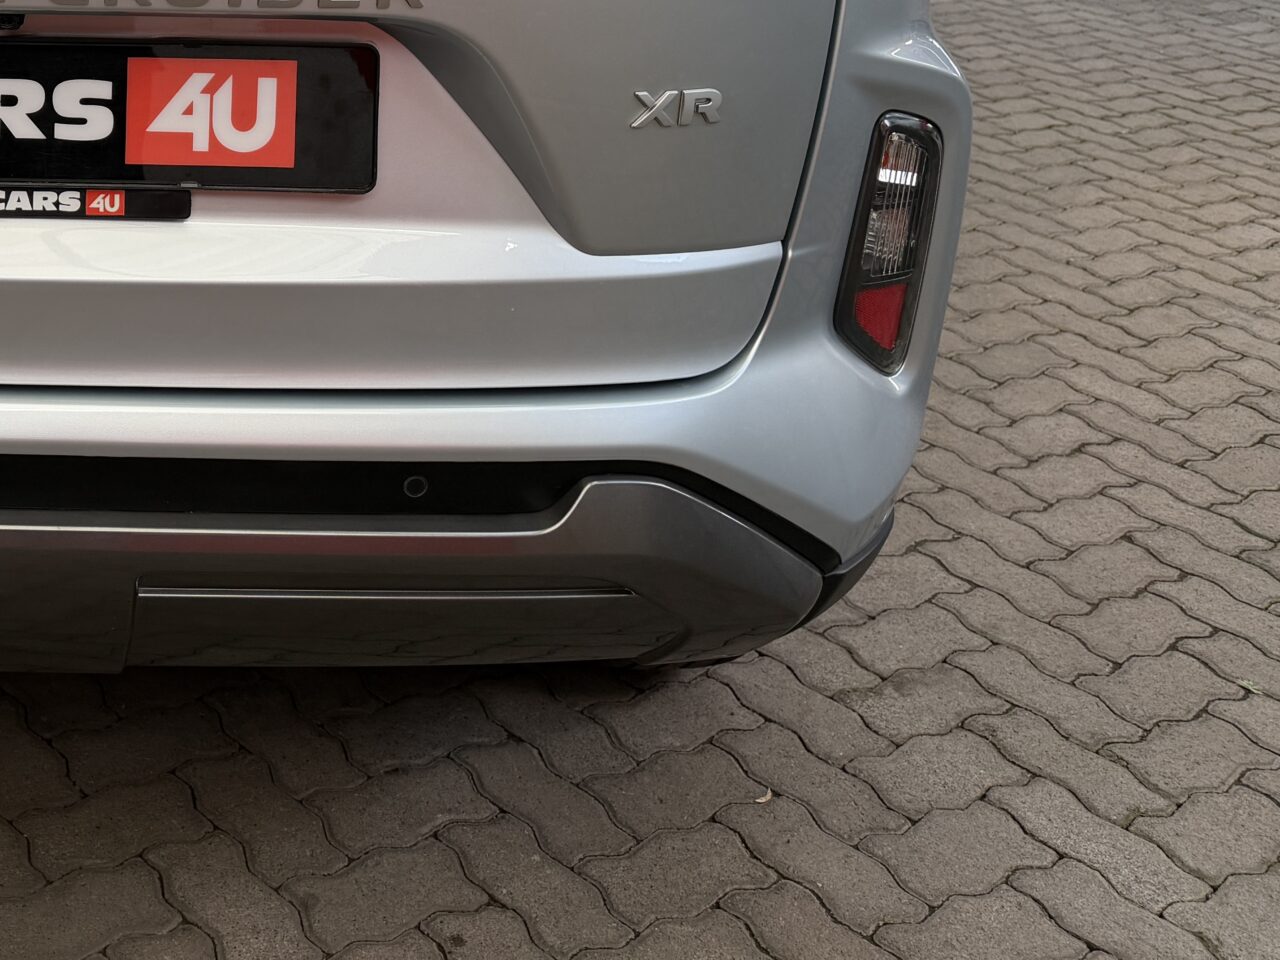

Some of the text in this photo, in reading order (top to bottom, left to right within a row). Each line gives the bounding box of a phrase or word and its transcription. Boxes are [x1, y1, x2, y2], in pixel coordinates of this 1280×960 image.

[145, 72, 278, 153] 4U
[629, 88, 722, 128] XR
[88, 193, 120, 214] 4U
